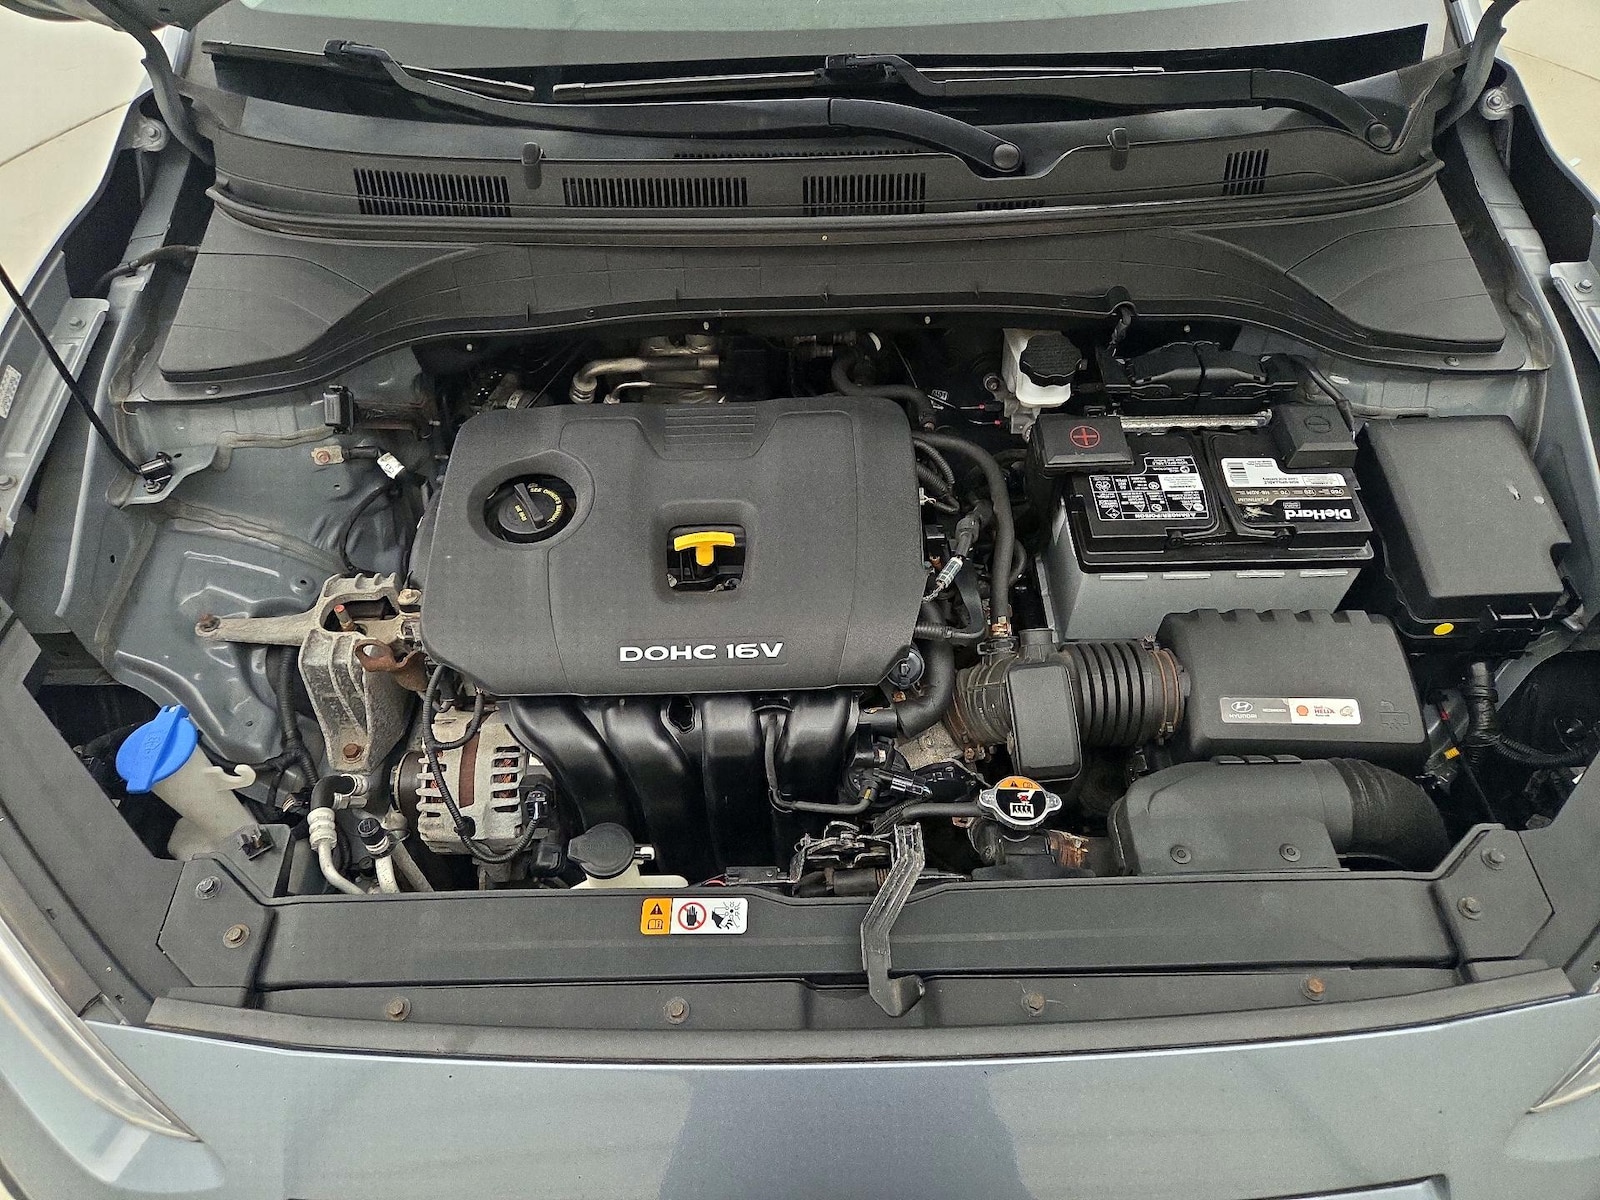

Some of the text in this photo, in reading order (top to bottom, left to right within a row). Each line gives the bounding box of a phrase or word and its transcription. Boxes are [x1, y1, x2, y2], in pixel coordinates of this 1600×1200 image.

[1284, 508, 1352, 520] DieHard
[619, 642, 784, 662] DOHC 16V
